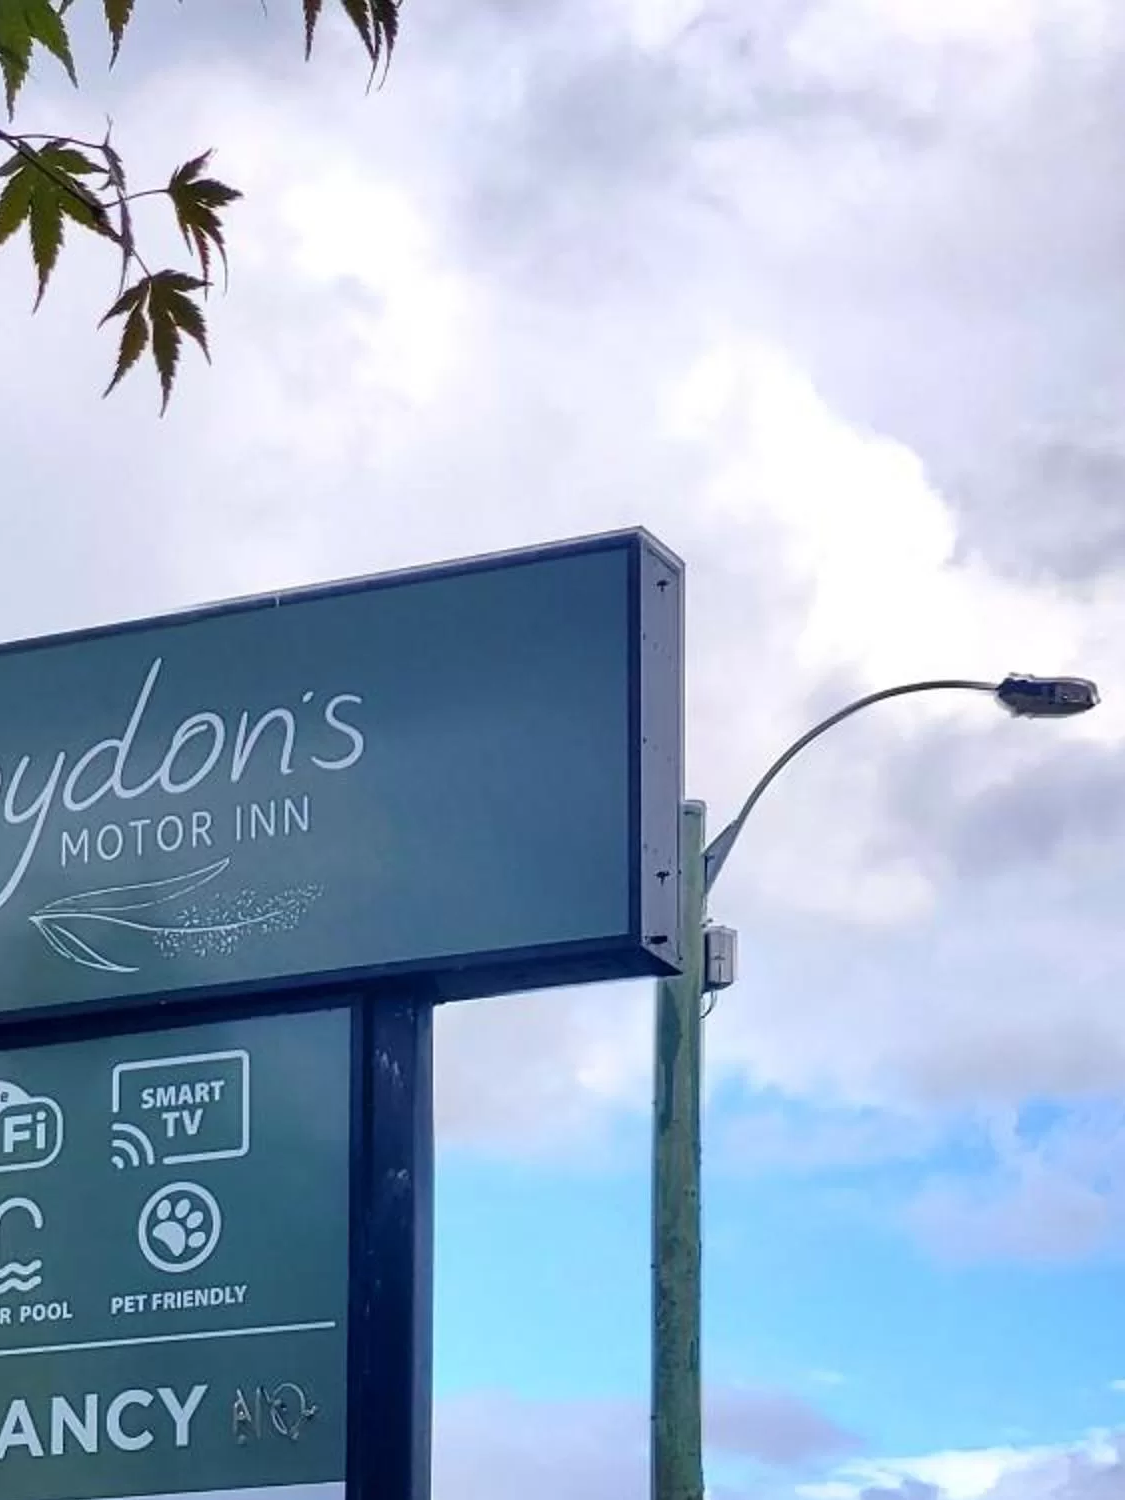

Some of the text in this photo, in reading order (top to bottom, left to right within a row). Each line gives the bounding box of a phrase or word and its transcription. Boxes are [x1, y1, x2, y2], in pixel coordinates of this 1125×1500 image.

[60, 796, 310, 868] MOTOR INN
[141, 1079, 225, 1110] SMART
[162, 1108, 204, 1138] TV
[19, 1300, 73, 1323] POOL
[111, 1284, 248, 1315] PET FRIENDLY
